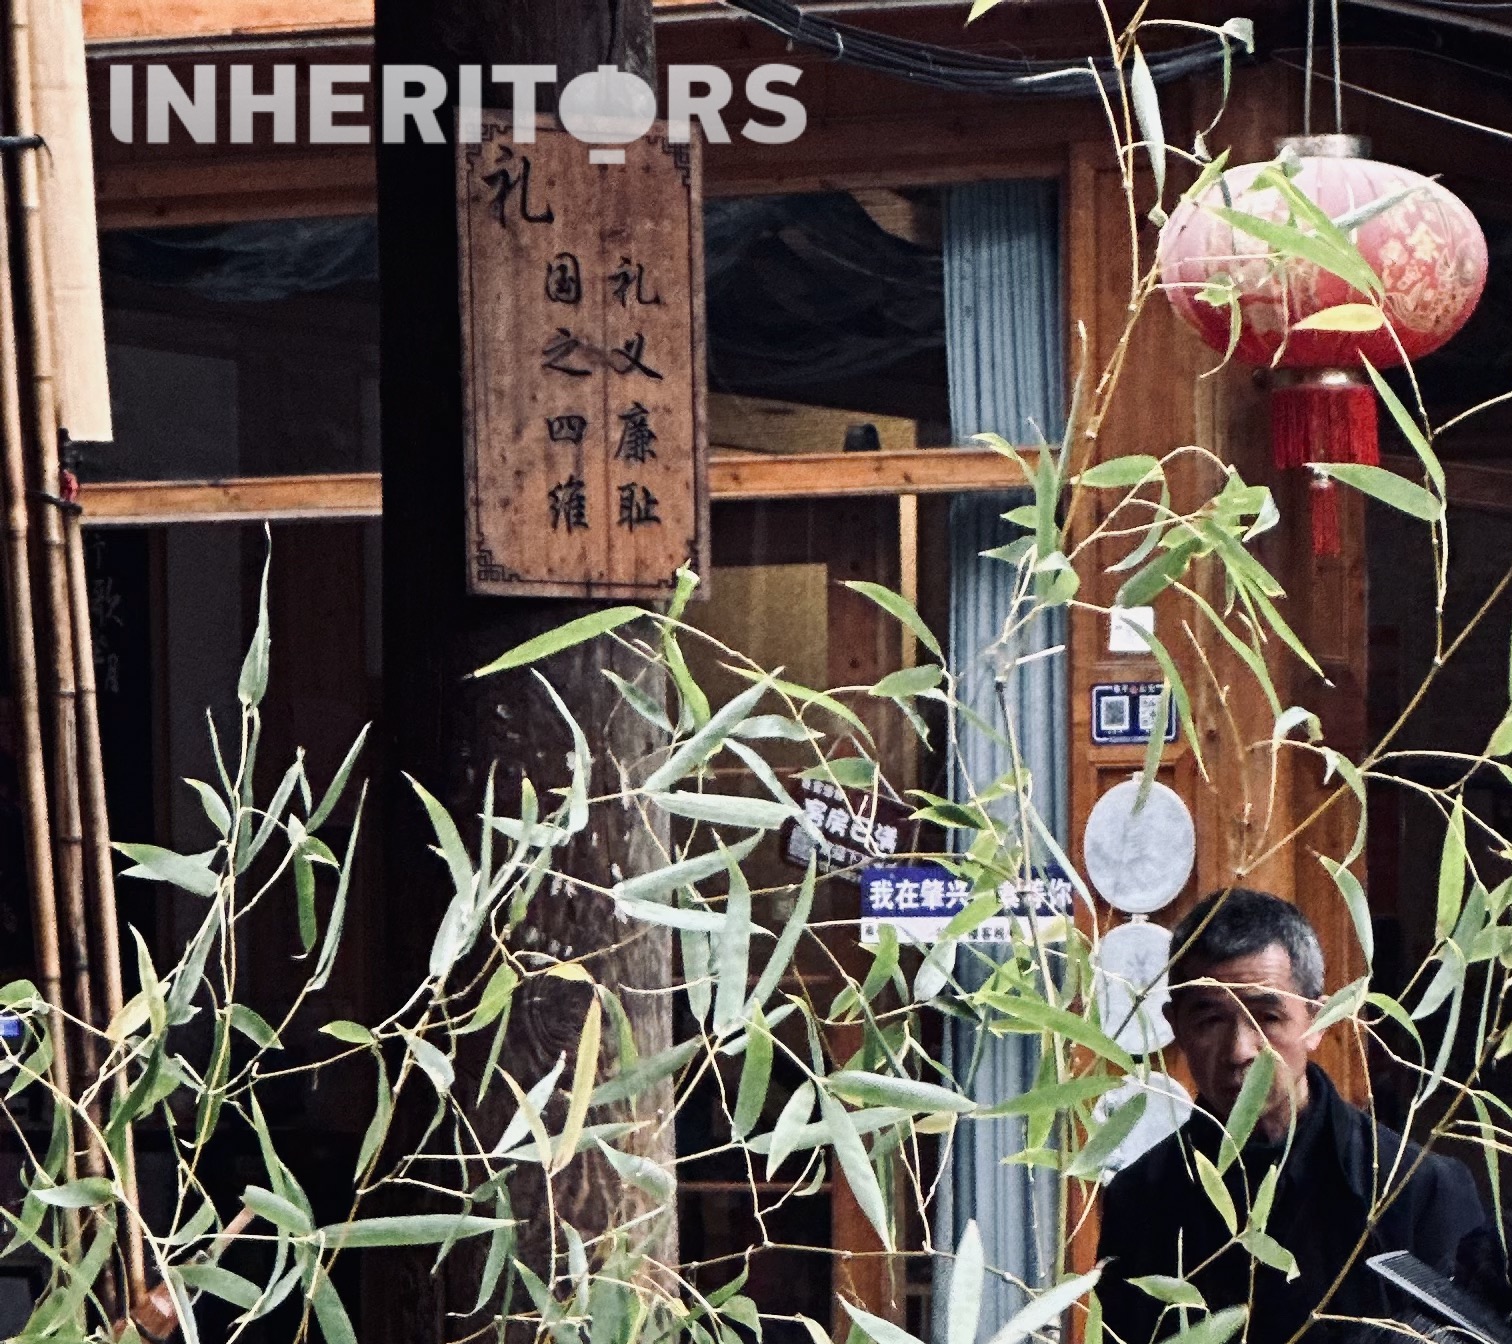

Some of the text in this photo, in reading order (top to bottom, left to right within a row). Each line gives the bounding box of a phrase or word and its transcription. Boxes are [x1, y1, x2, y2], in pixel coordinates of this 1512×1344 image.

[482, 146, 555, 229] 礼
[607, 256, 664, 529] 礼义廉耻
